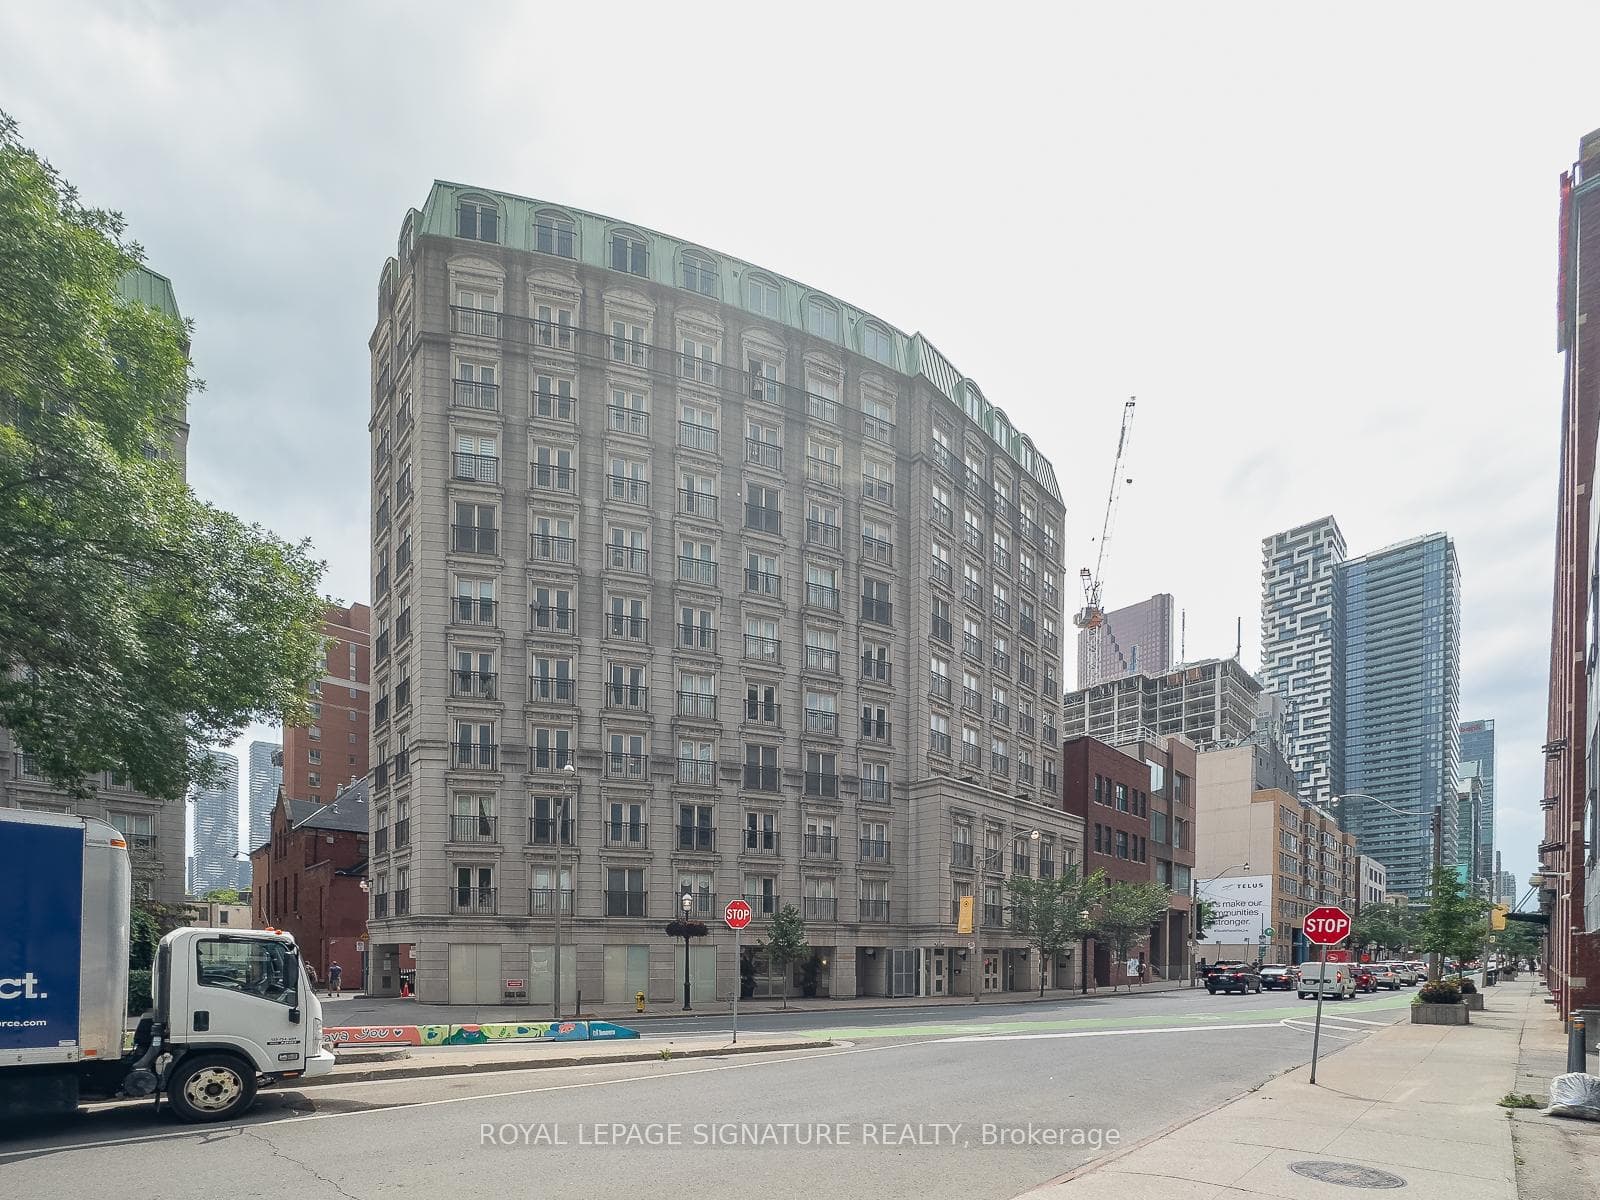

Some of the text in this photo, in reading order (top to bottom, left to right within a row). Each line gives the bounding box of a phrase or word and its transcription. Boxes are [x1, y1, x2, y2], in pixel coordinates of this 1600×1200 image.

[726, 909, 750, 921] STOP
[1215, 908, 1259, 917] mmunities
[1306, 918, 1348, 933] STOP
